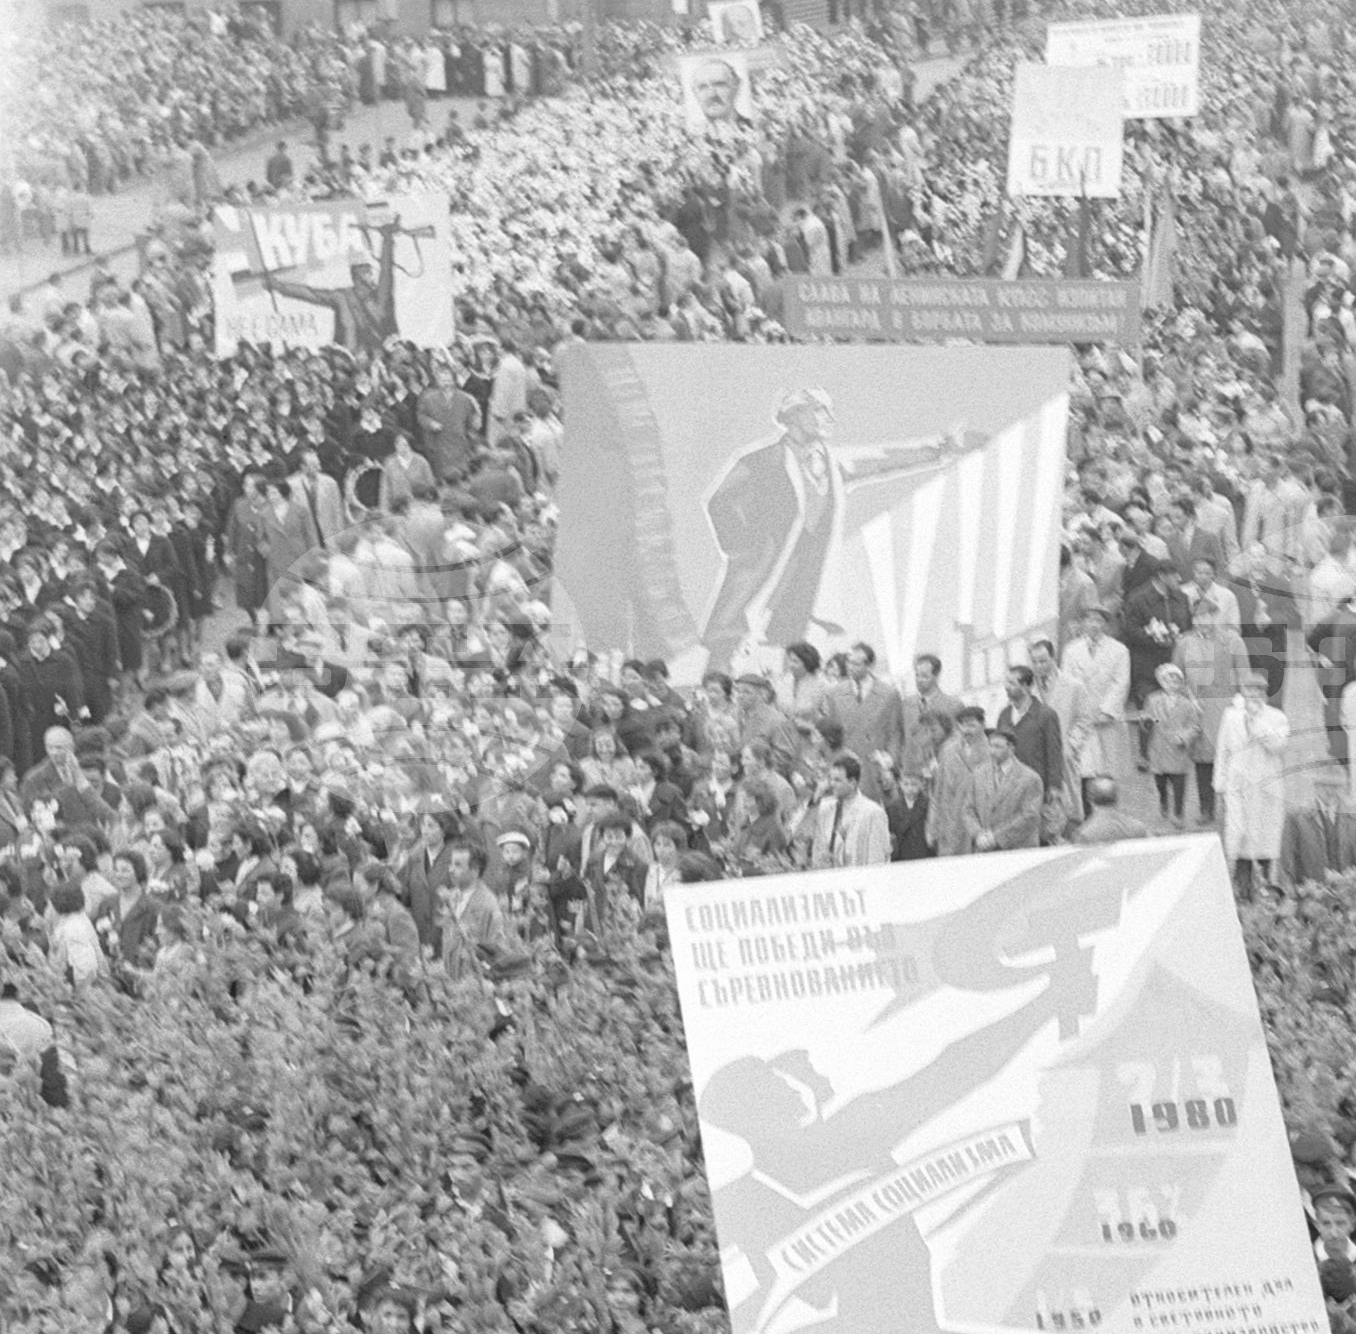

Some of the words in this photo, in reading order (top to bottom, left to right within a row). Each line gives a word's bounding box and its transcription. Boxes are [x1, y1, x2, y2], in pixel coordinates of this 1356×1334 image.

[1029, 145, 1102, 182] БКП
[251, 211, 365, 269] КУБА
[684, 889, 867, 934] СОЦИАЛИЗМЪТ
[691, 939, 729, 972] ЩЕ
[737, 927, 837, 966] ПОБЕДИ
[698, 956, 921, 1009] СЪРЕВНОВАНИЕТО
[1129, 1097, 1238, 1136] 1980
[780, 1200, 877, 1272] СИСТЕМА
[872, 1134, 1018, 1214] СОЦИАЛИЗМА
[1101, 1218, 1178, 1244] 1960
